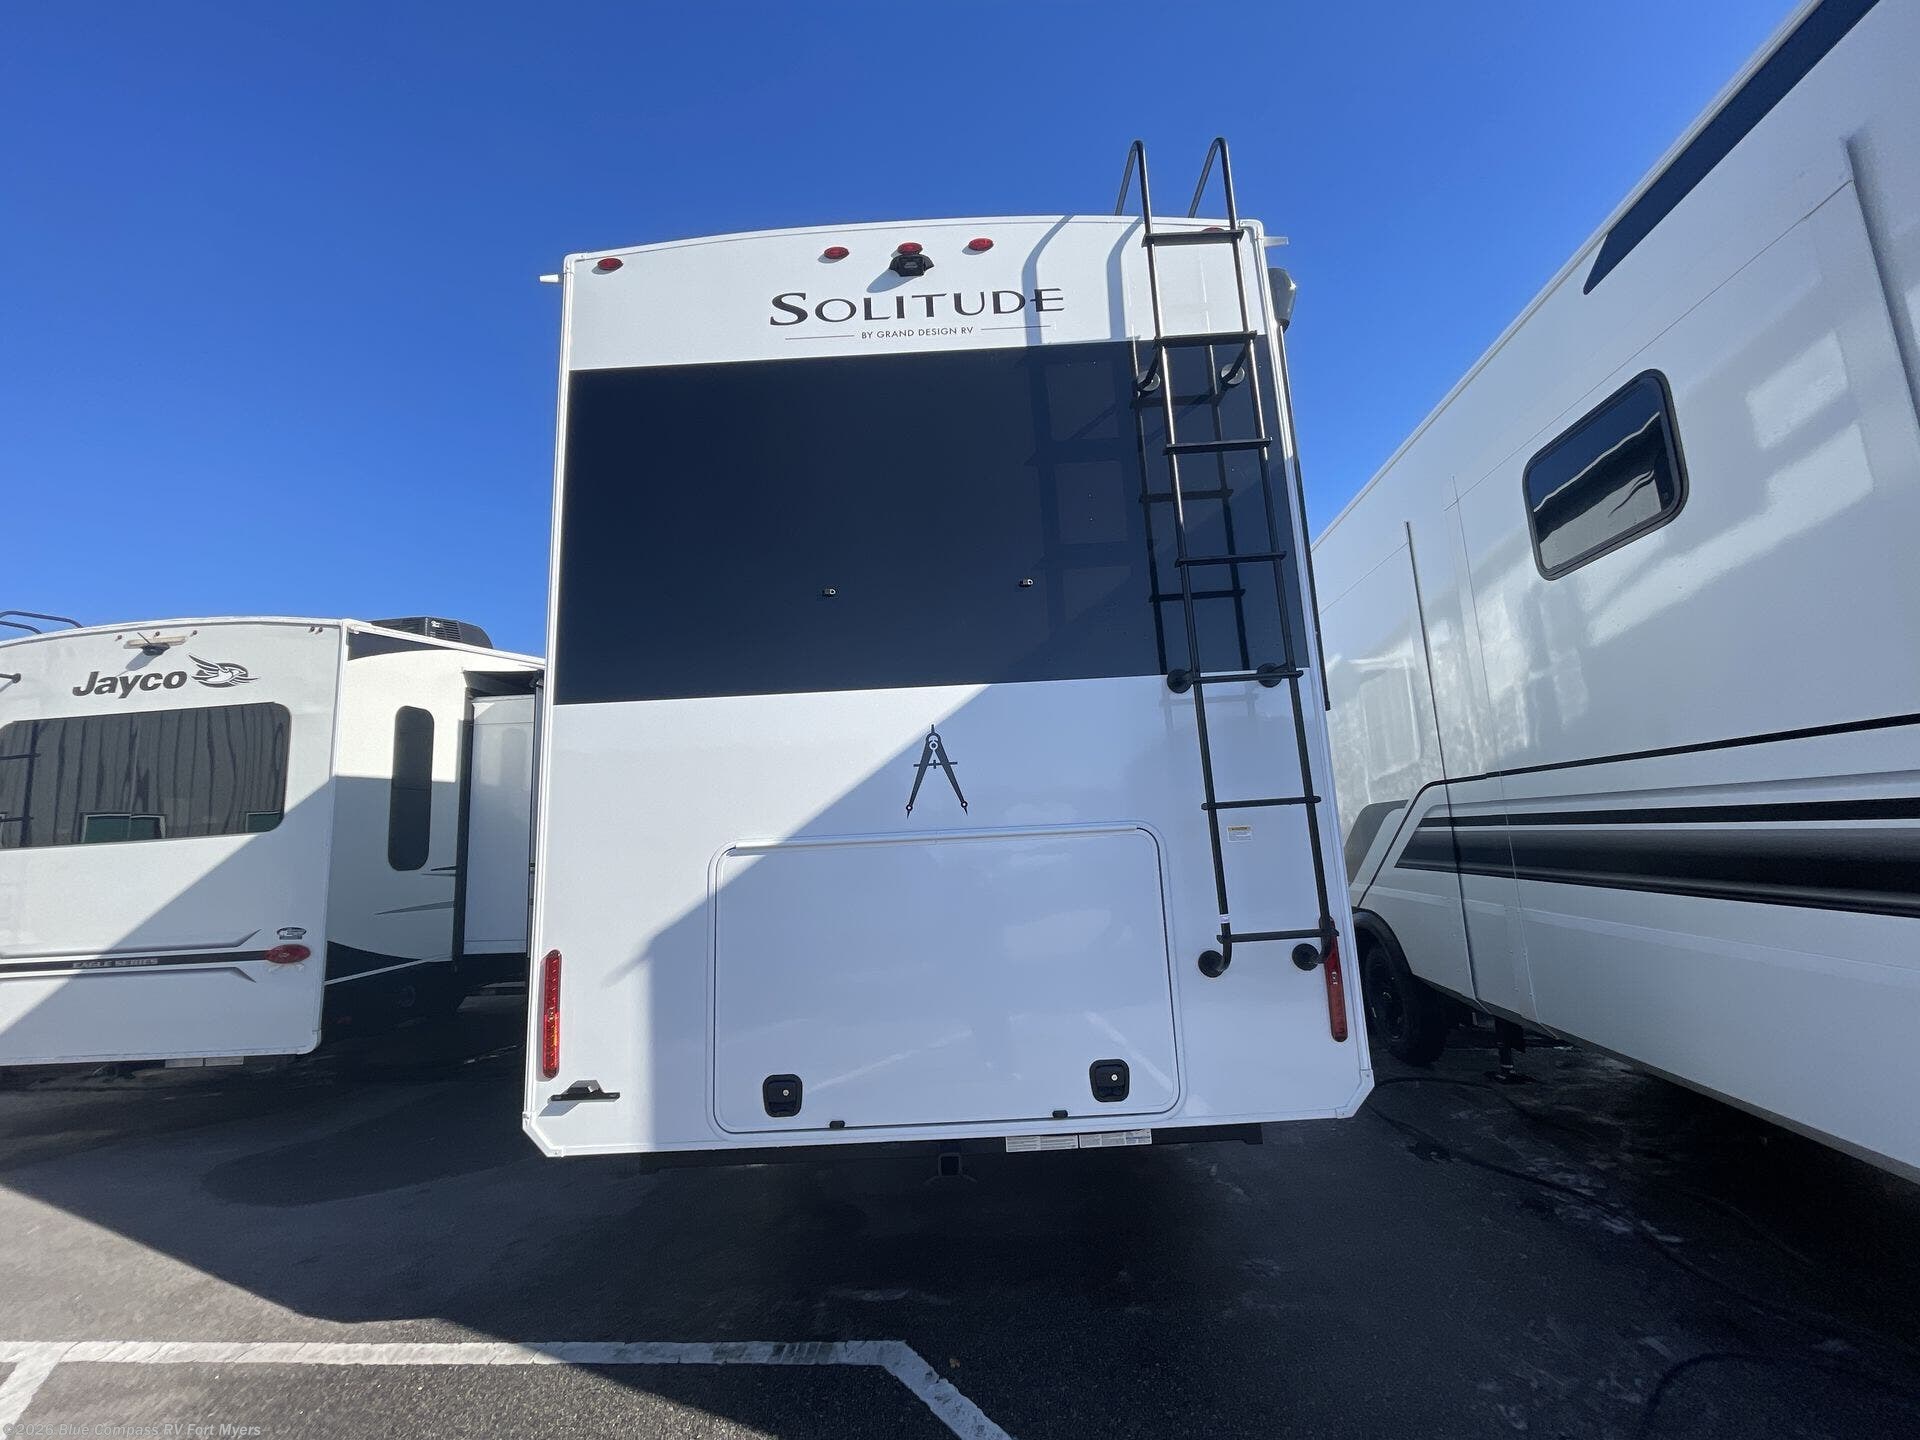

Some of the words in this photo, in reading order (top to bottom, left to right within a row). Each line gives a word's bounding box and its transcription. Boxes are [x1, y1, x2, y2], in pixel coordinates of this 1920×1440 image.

[769, 287, 1065, 326] SOLITUDE
[861, 331, 873, 339] BY
[877, 329, 915, 339] GRAND
[918, 327, 957, 337] DESIGN
[961, 326, 974, 335] RV
[72, 670, 188, 699] Jayco
